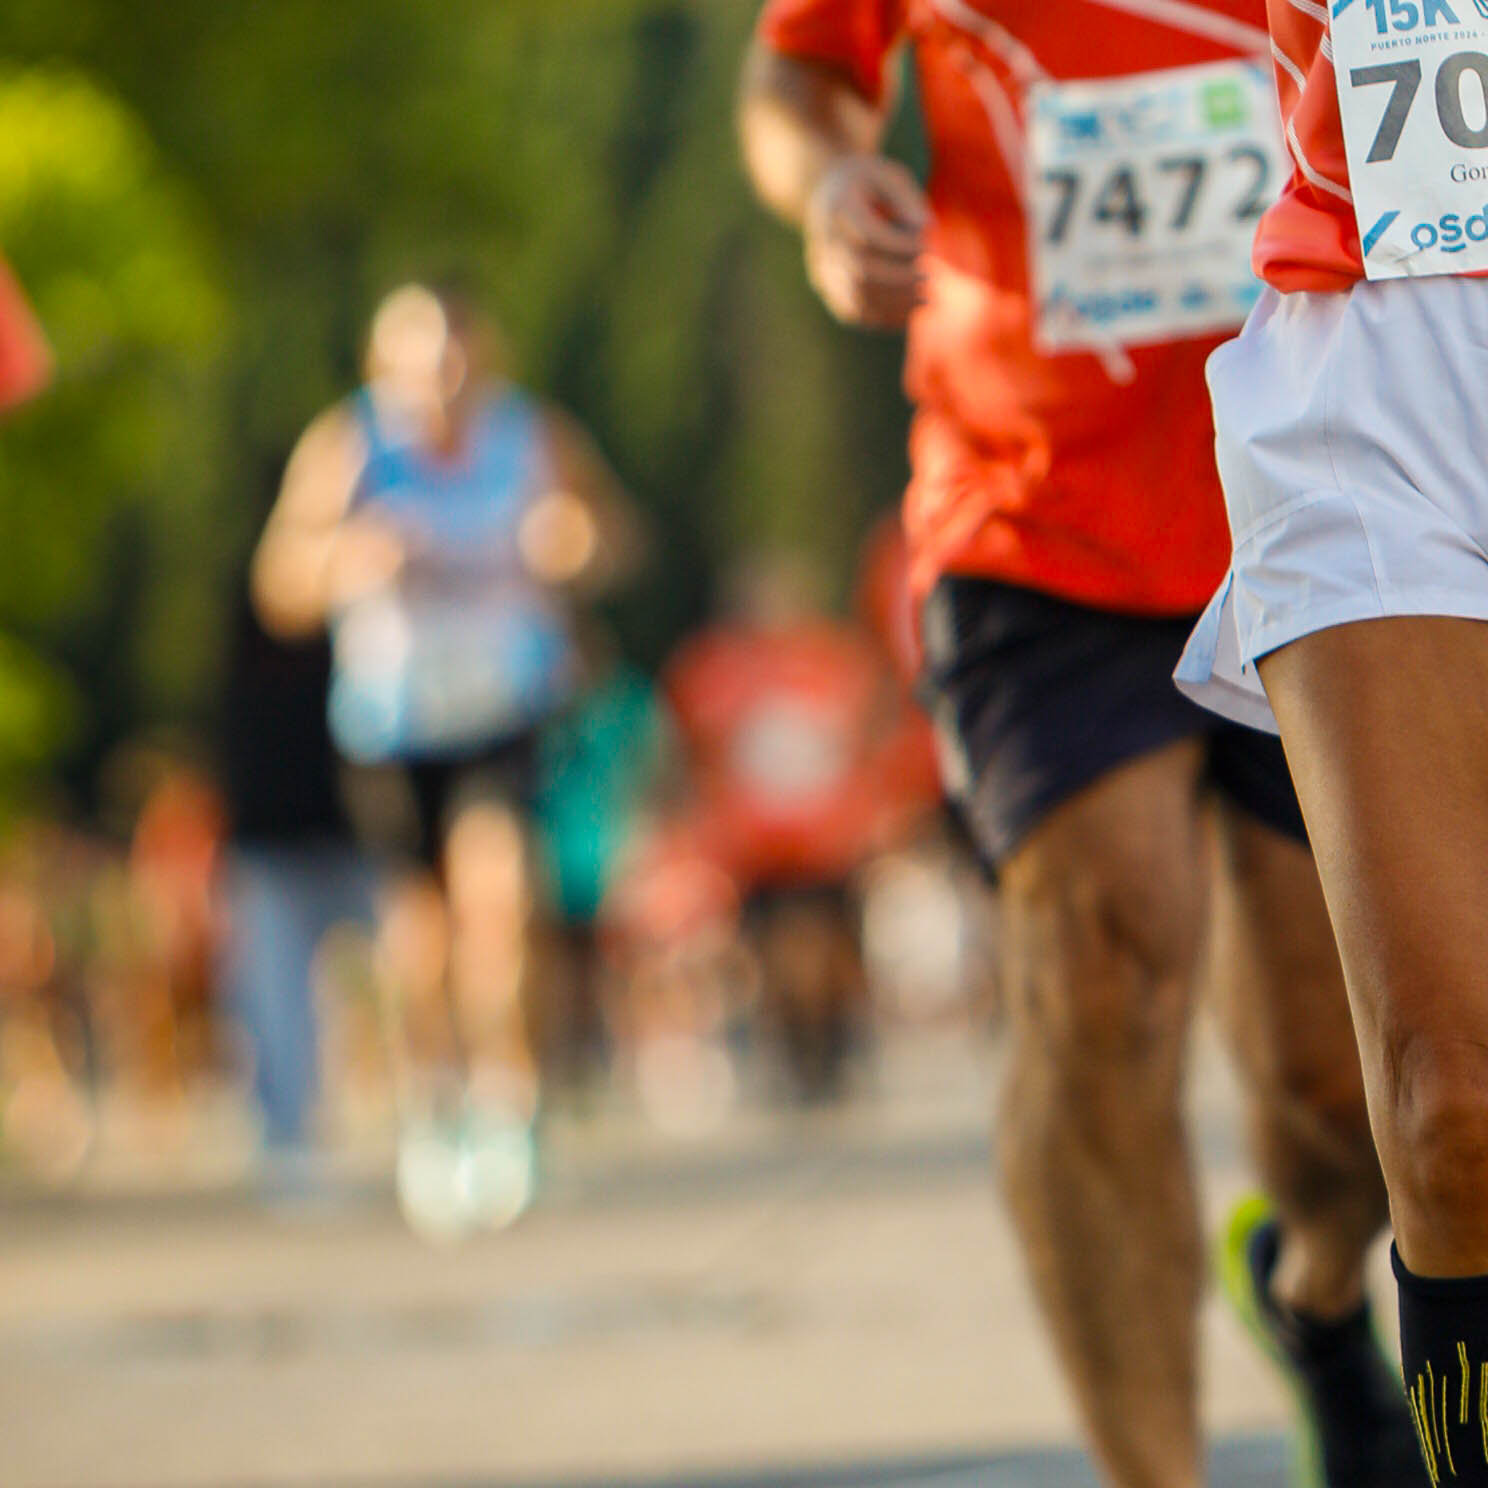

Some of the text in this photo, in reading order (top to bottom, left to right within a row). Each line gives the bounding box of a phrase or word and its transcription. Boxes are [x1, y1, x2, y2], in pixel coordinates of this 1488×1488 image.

[1371, 37, 1412, 51] PUERTO
[1415, 31, 1450, 45] NORTE
[1044, 142, 1271, 248] 7472
